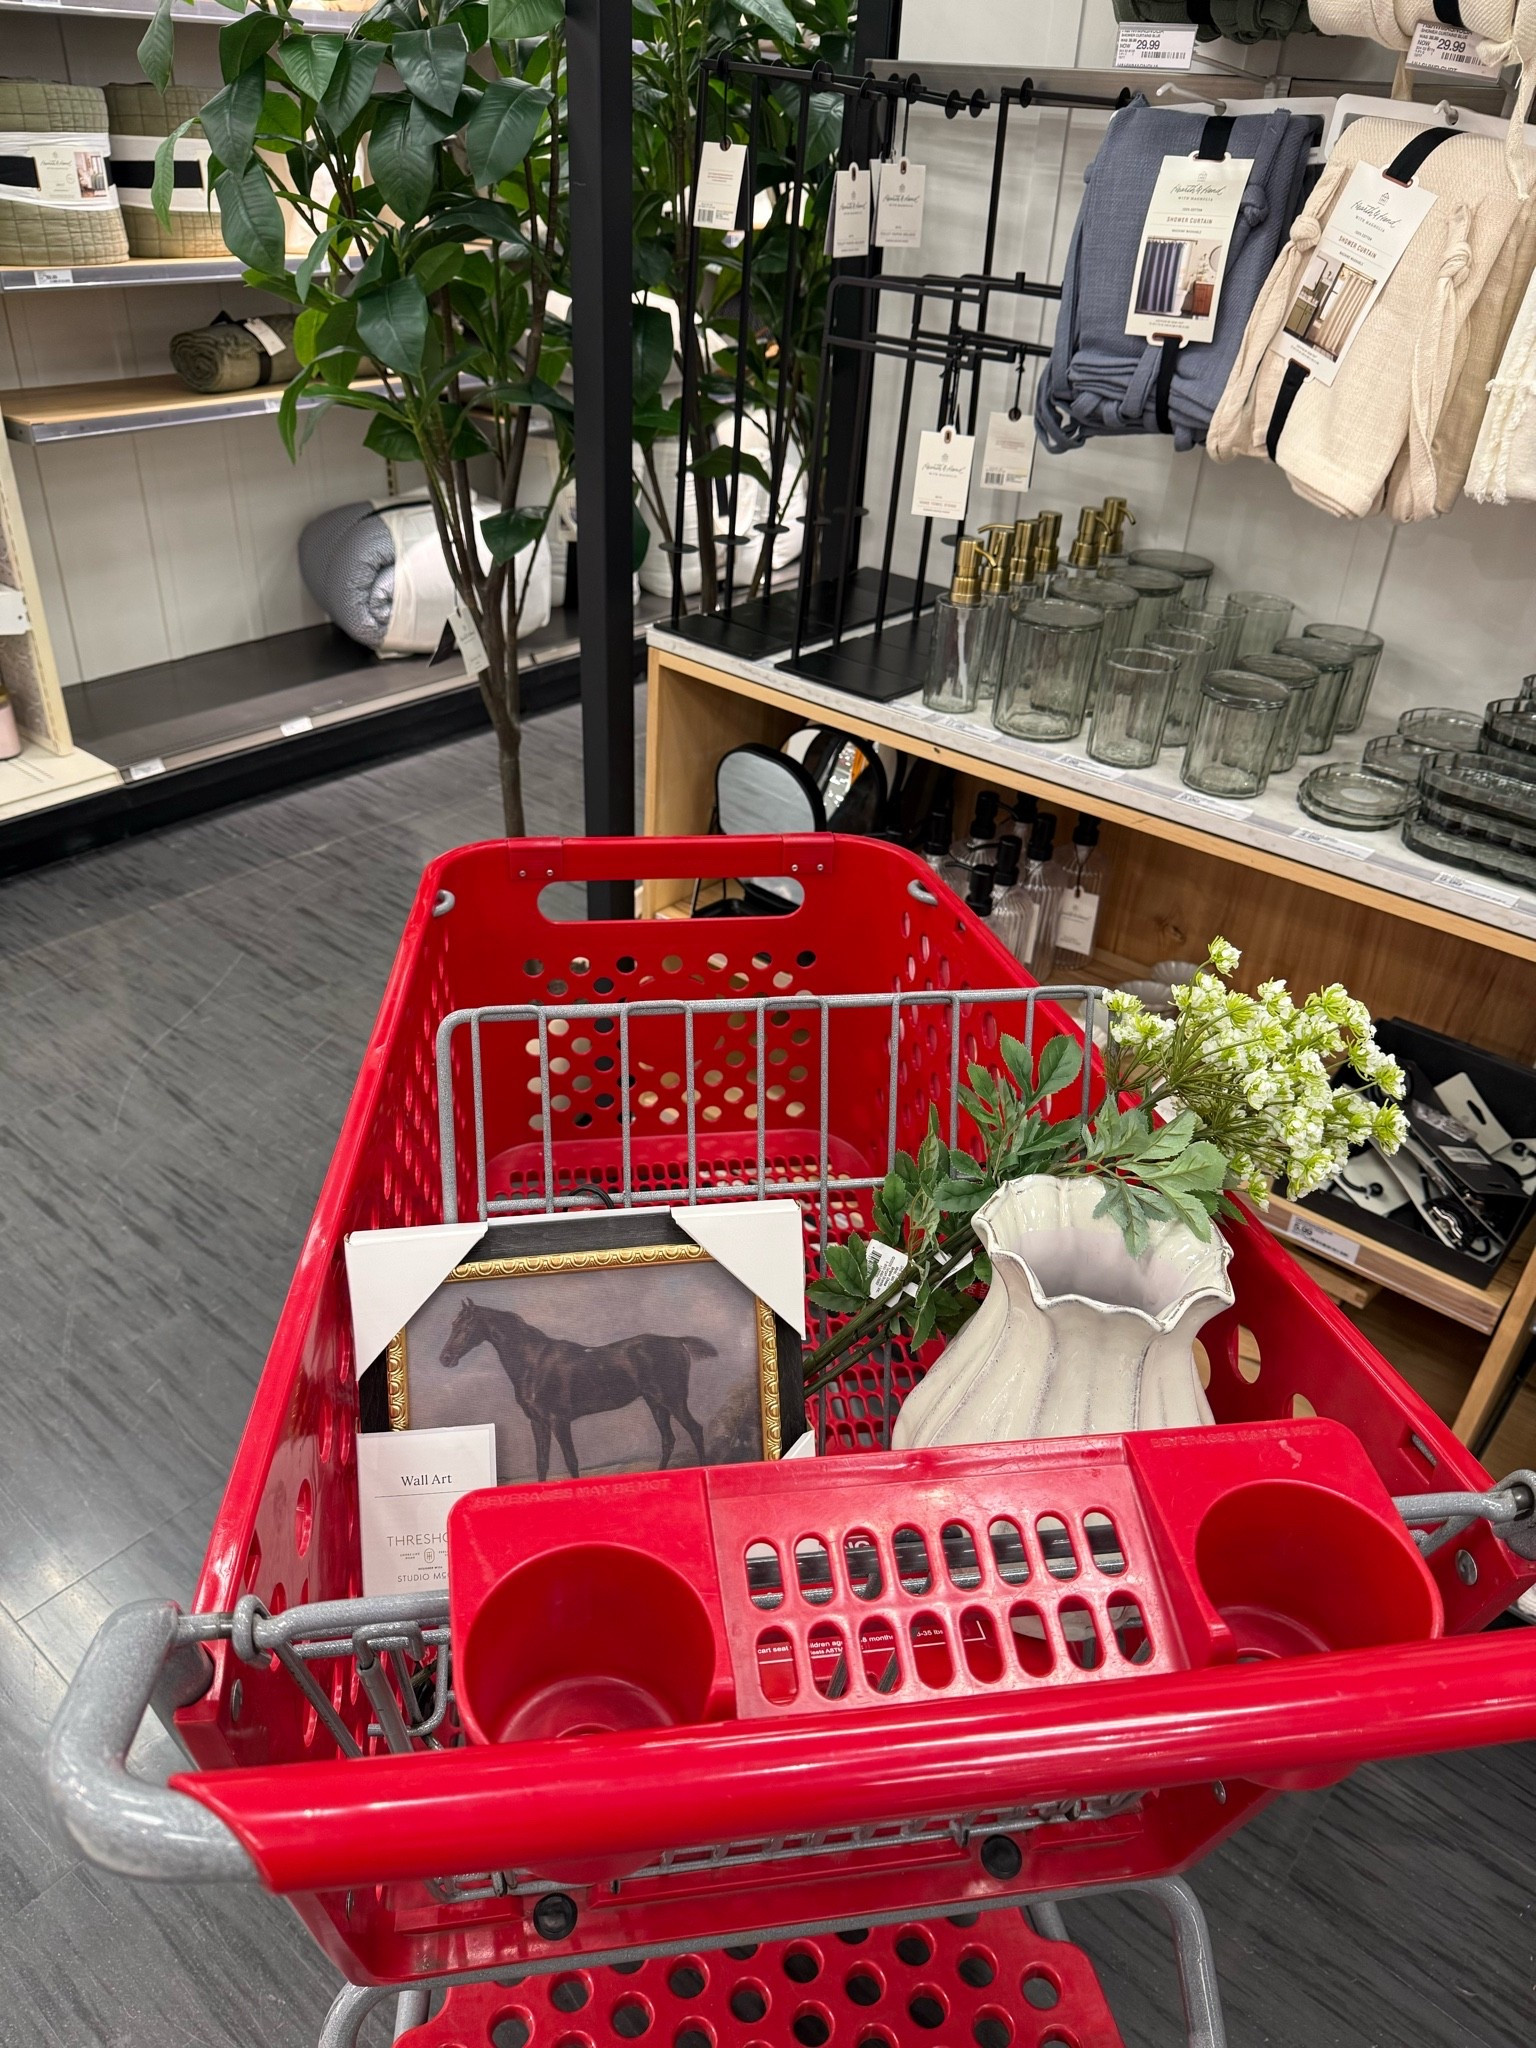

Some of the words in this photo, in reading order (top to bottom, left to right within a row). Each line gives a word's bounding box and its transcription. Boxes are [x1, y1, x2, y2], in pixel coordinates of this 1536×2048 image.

[1136, 40, 1160, 49] 29.99
[1437, 39, 1466, 52] 29.99
[1351, 200, 1377, 217] Hearth
[1376, 213, 1401, 228] Hand
[1339, 236, 1357, 248] SHOWER
[1357, 244, 1377, 259] CURTAIN
[401, 1474, 428, 1487] Wall
[432, 1473, 452, 1485] Art
[398, 1573, 429, 1582] STUDIO
[757, 1646, 771, 1654] cart
[773, 1645, 789, 1653] seat
